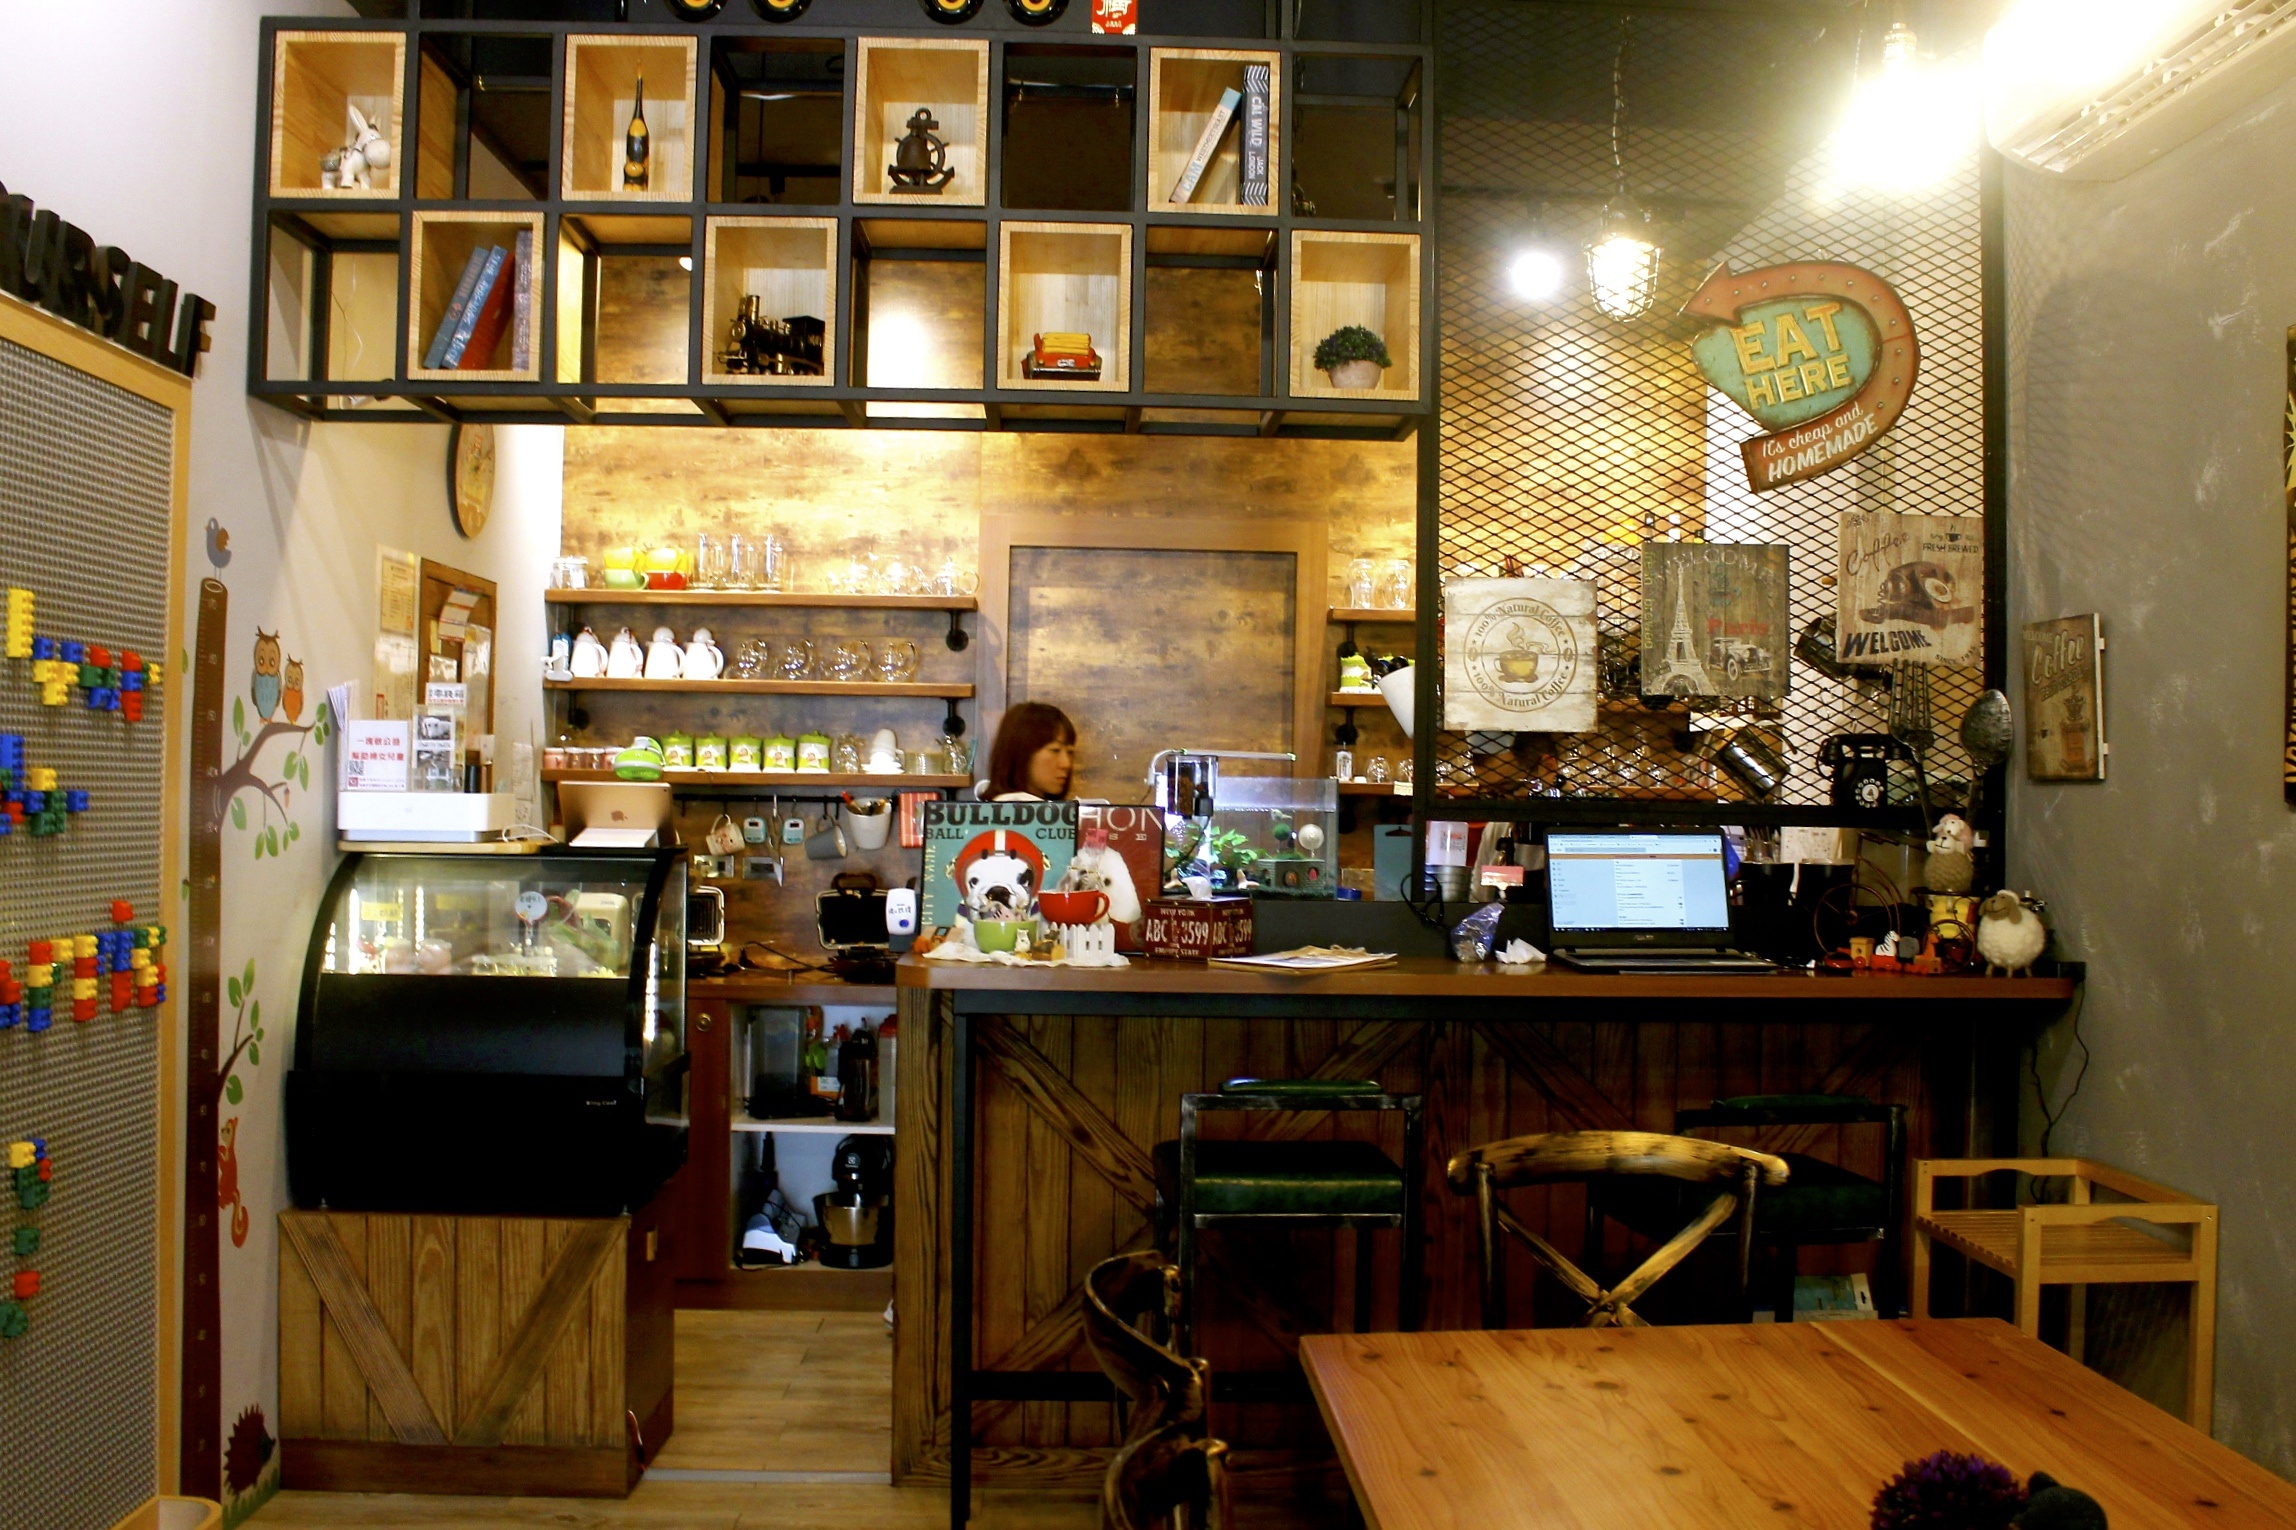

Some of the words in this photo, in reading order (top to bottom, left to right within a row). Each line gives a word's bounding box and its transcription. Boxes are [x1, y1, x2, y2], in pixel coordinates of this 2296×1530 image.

[0, 181, 216, 378] URSELF
[1730, 302, 1842, 376] EAT
[1744, 354, 1853, 411] HERE
[1788, 423, 1832, 449] cheap
[1835, 401, 1864, 428] and
[1768, 413, 1879, 483] HOMEMADE
[1847, 532, 1910, 576] Coffee
[1475, 614, 1497, 638] 100%
[1496, 603, 1540, 615] Natural
[1540, 610, 1566, 637] Coffee
[1707, 618, 1769, 636] Paris
[1842, 629, 1932, 659] WELCOME
[2032, 630, 2084, 685] Coffee
[1474, 673, 1496, 698] 100%
[1498, 692, 1541, 708] Natural
[1539, 673, 1568, 701] Coffee
[926, 803, 1076, 826] BULLDOG
[926, 828, 964, 840] BALL
[1036, 827, 1076, 840] CLUB
[1145, 918, 1168, 943] ABC
[1181, 921, 1209, 945] 3599
